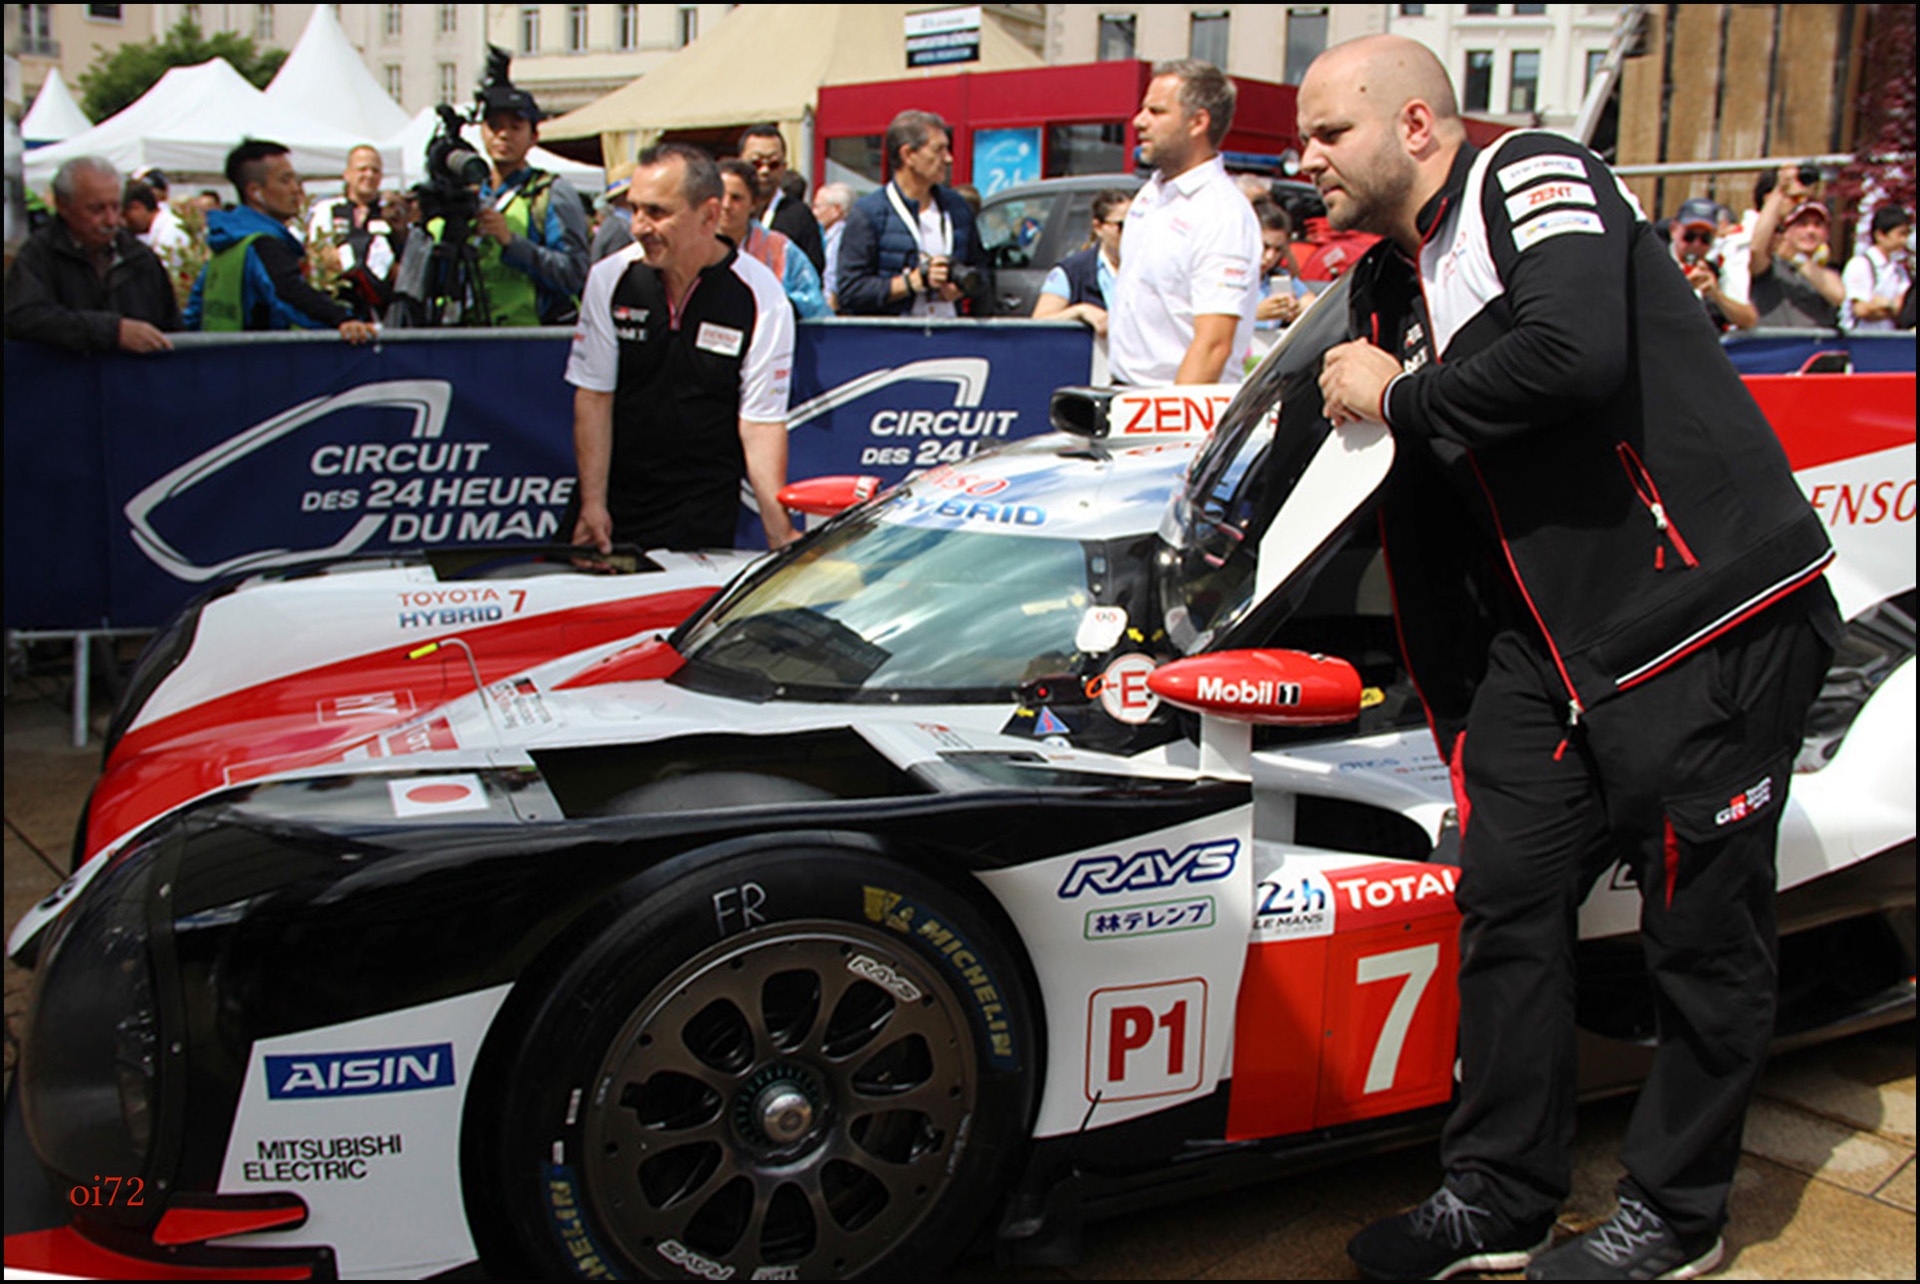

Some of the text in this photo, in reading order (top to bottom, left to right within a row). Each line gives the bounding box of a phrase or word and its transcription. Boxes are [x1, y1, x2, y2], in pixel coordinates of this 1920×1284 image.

[870, 410, 1018, 436] CIRCUIT
[311, 444, 490, 474] CIRCUIT
[861, 448, 911, 465] DES
[915, 440, 964, 465] 24
[302, 477, 577, 512] DES 24 HEURE
[1811, 480, 1917, 526] ENSO
[389, 510, 558, 542] DU MAN
[398, 588, 527, 613] TOYOTA 7
[400, 605, 502, 628] HYBRID
[1121, 671, 1148, 708] E
[1197, 676, 1298, 705] Mobil 1
[1058, 838, 1240, 899] RAYS
[712, 882, 767, 936] FR
[1096, 902, 1208, 933] 林テレンプ
[1277, 912, 1323, 928] MANS
[847, 954, 922, 1002] RAYS
[918, 919, 1013, 1057] MICHELIN
[1356, 943, 1440, 1094] 7
[1108, 1000, 1187, 1082] P1
[281, 1053, 439, 1092] AISIN
[257, 1134, 402, 1160] MITSUBISHI
[243, 1159, 367, 1182] ELECTRIC
